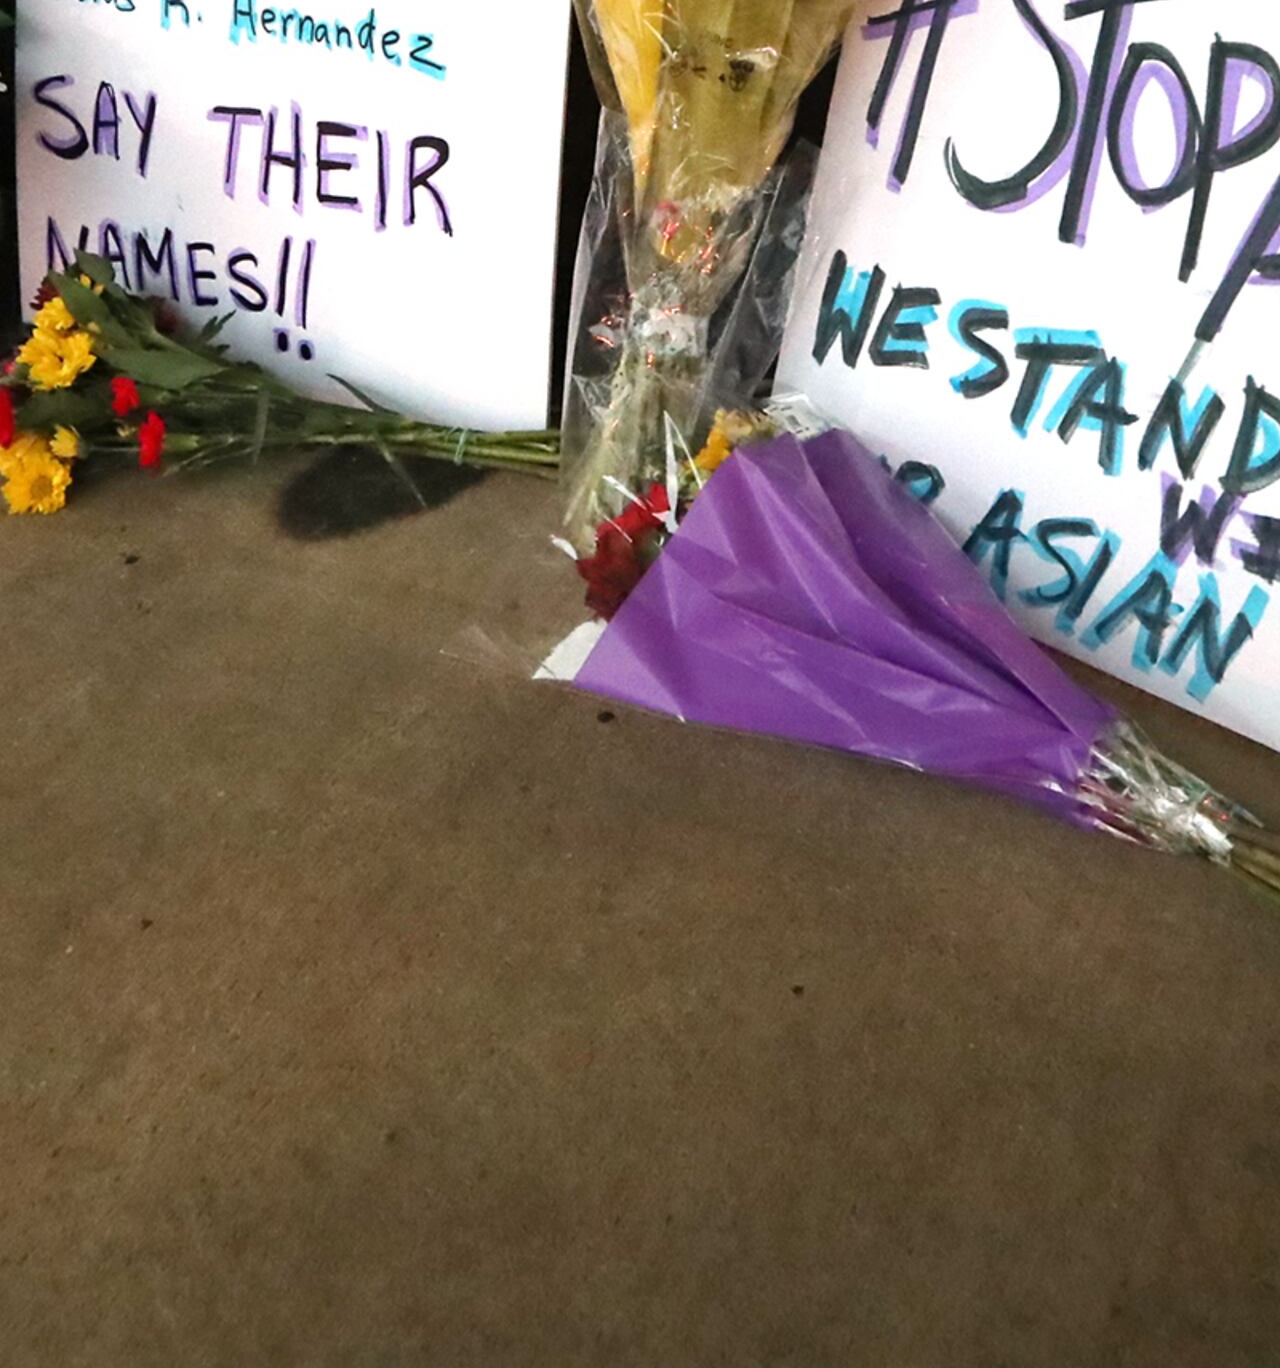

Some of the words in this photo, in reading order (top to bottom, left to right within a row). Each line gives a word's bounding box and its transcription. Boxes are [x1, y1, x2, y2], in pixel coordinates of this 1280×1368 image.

[32, 73, 158, 178] SAY
[207, 100, 454, 238] THEIR
[960, 488, 1270, 701] ASIAN
